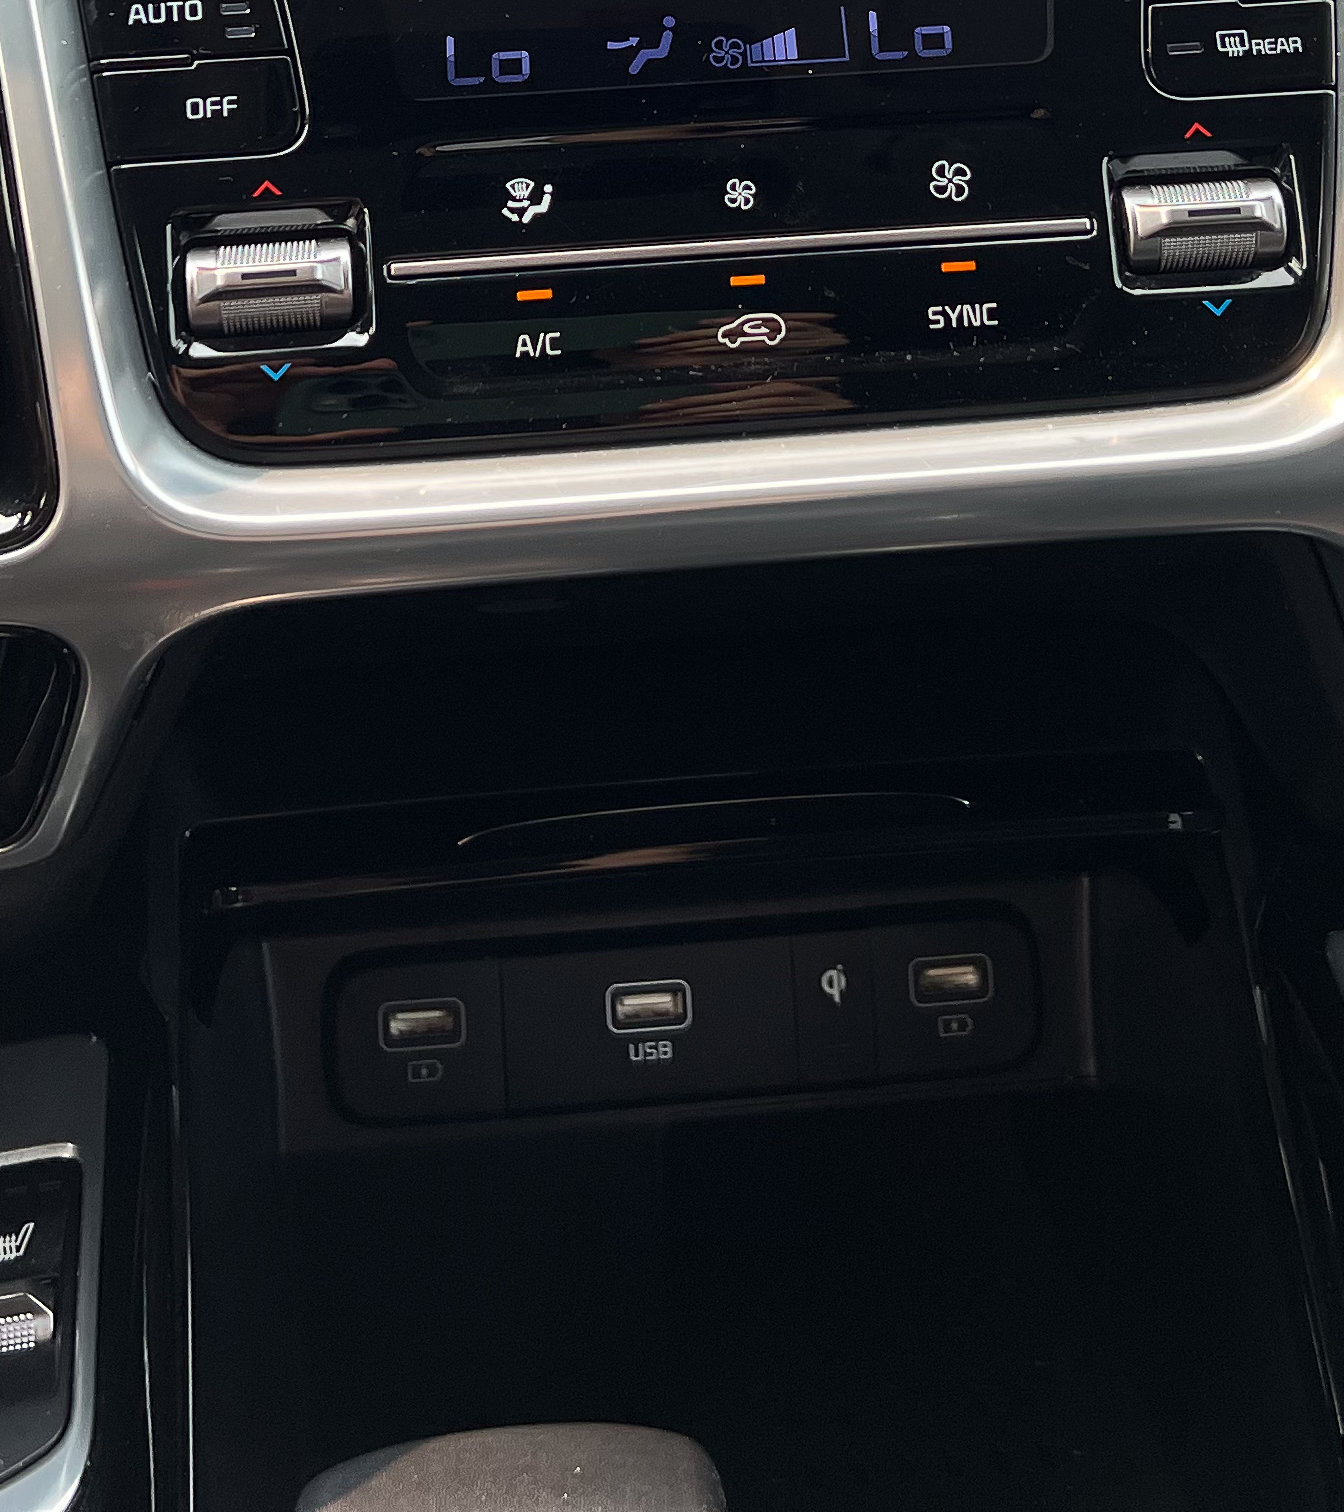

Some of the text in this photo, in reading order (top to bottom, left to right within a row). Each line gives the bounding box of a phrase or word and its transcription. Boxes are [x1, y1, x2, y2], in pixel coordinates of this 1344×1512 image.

[127, 0, 203, 26] AUTO
[1251, 37, 1303, 56] REAR
[185, 95, 238, 120] OFF
[927, 303, 999, 330] SYNC
[515, 332, 562, 358] A/C
[628, 1041, 674, 1062] USB
